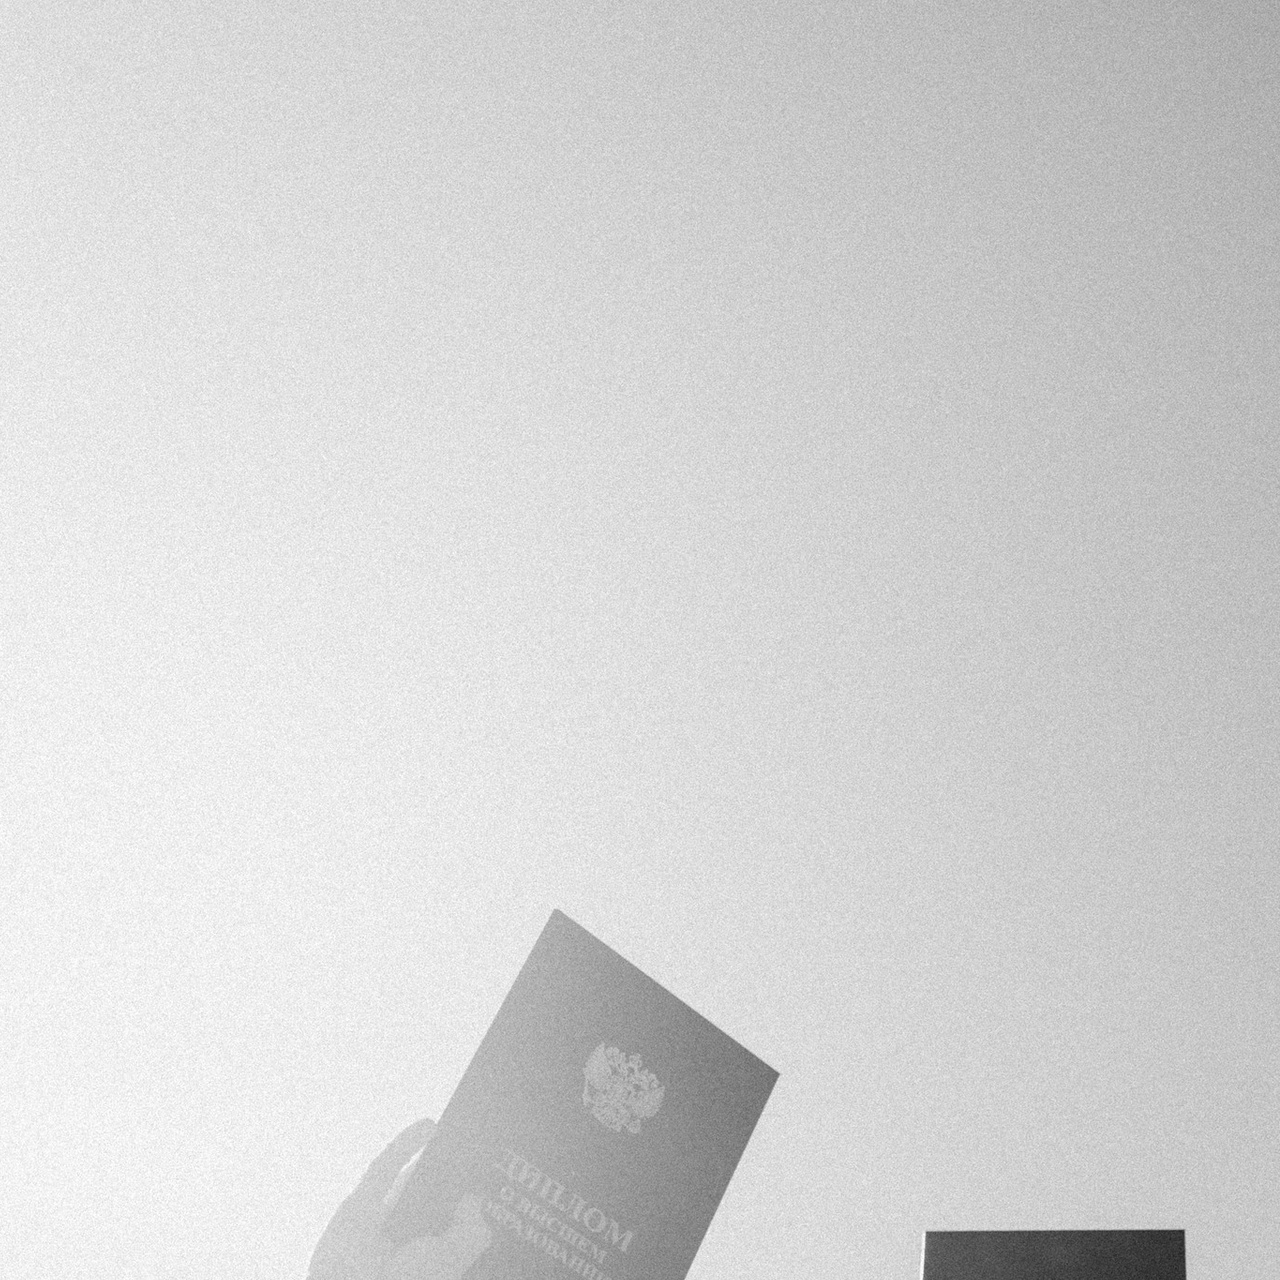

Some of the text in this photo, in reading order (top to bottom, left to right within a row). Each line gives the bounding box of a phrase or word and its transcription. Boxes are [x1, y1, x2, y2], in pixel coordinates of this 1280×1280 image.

[494, 1148, 634, 1252] ДИПЛОМ
[500, 1186, 607, 1263] О ВЫСШЕМ
